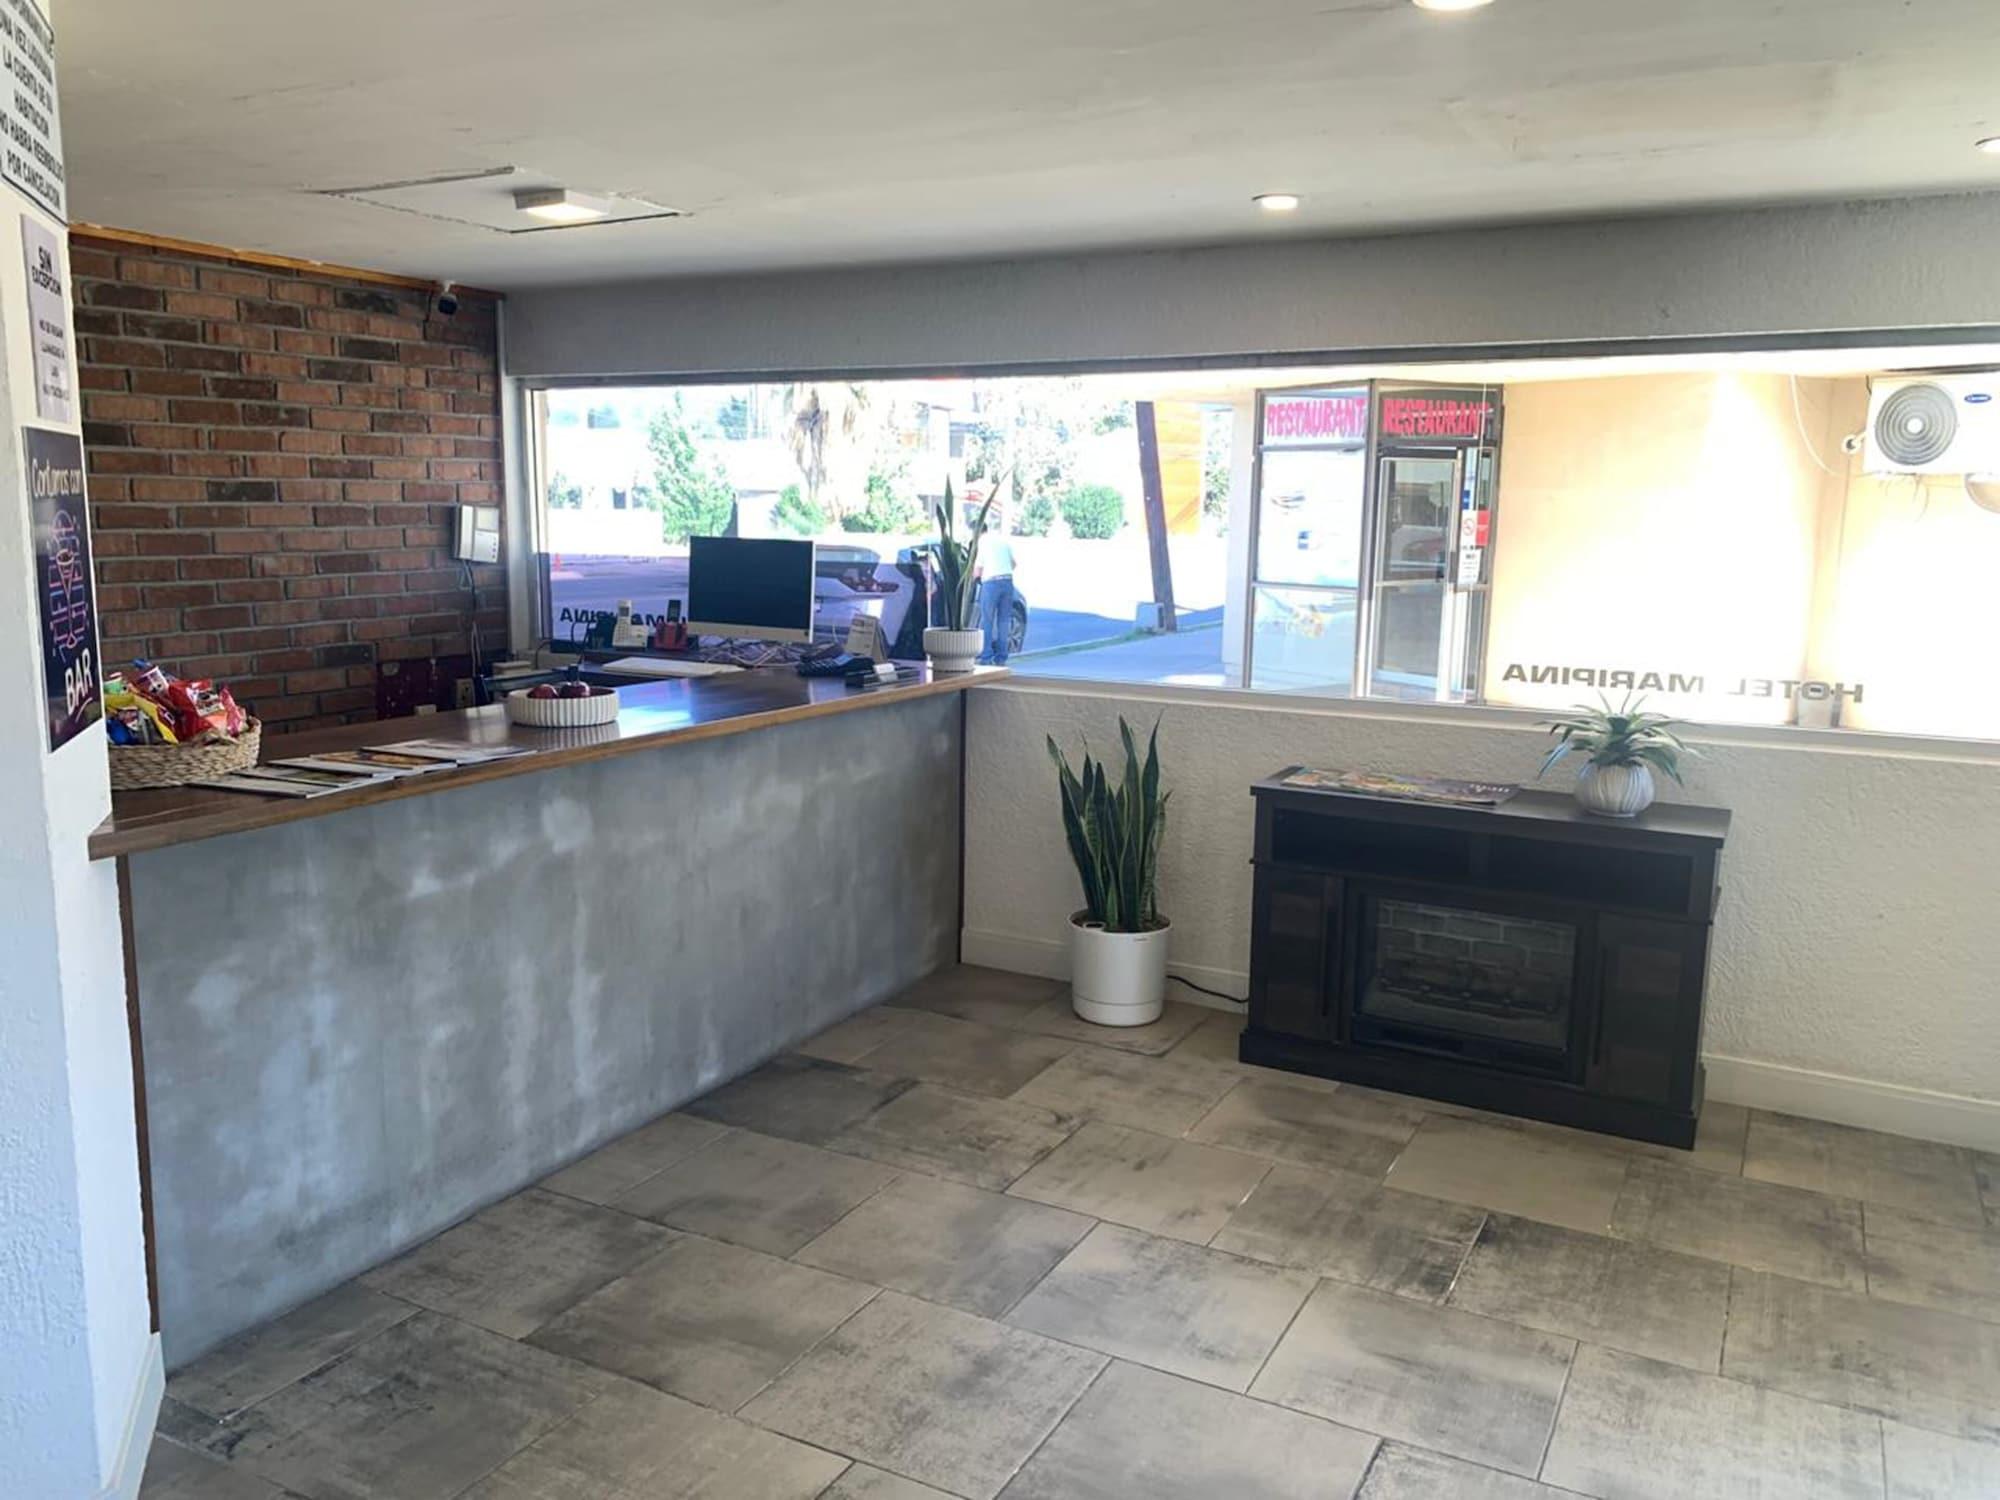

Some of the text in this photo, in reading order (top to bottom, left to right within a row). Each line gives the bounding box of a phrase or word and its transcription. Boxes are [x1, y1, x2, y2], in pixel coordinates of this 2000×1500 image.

[14, 56, 37, 96] CUENTA
[39, 245, 52, 274] SIN
[1266, 398, 1367, 437] RESTAURANT
[1382, 399, 1490, 436] RESTAURANT
[64, 648, 93, 716] BAR
